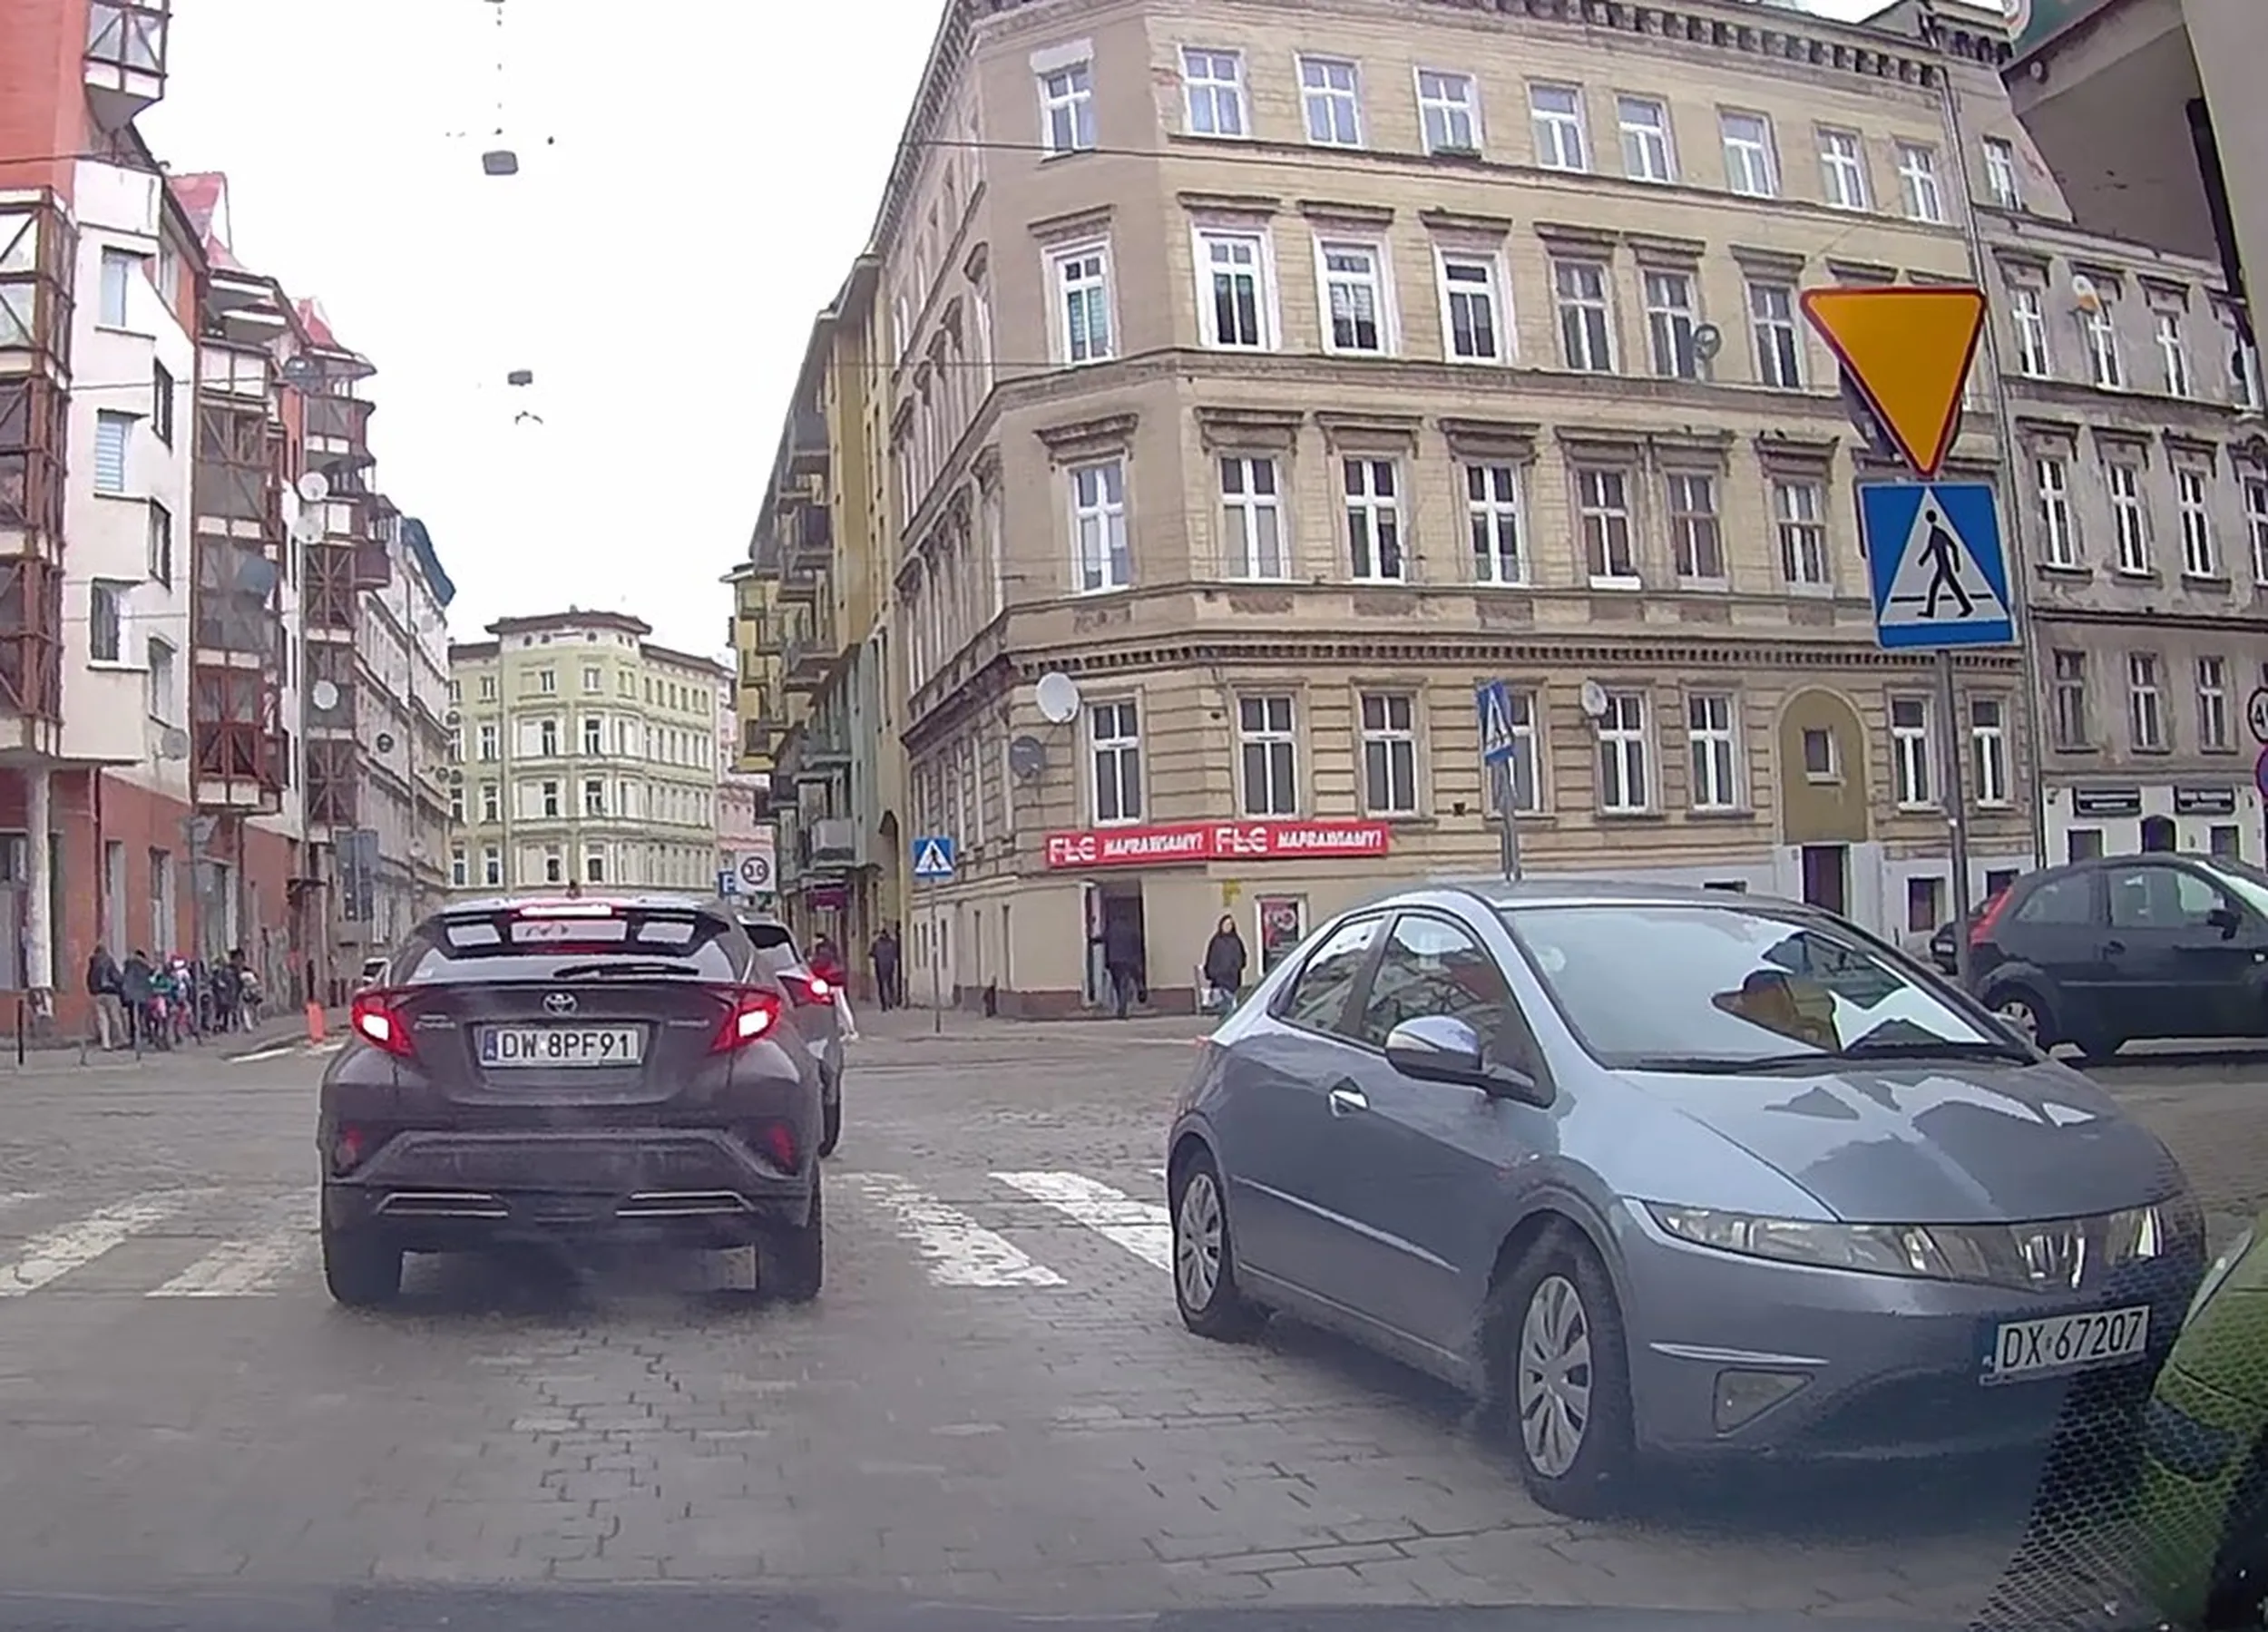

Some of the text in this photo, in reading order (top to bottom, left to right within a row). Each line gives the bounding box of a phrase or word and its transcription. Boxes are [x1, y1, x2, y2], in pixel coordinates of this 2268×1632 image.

[502, 1033, 537, 1058] DW
[547, 1032, 630, 1059] 8PF91
[2003, 1312, 2143, 1368] DX 67207
